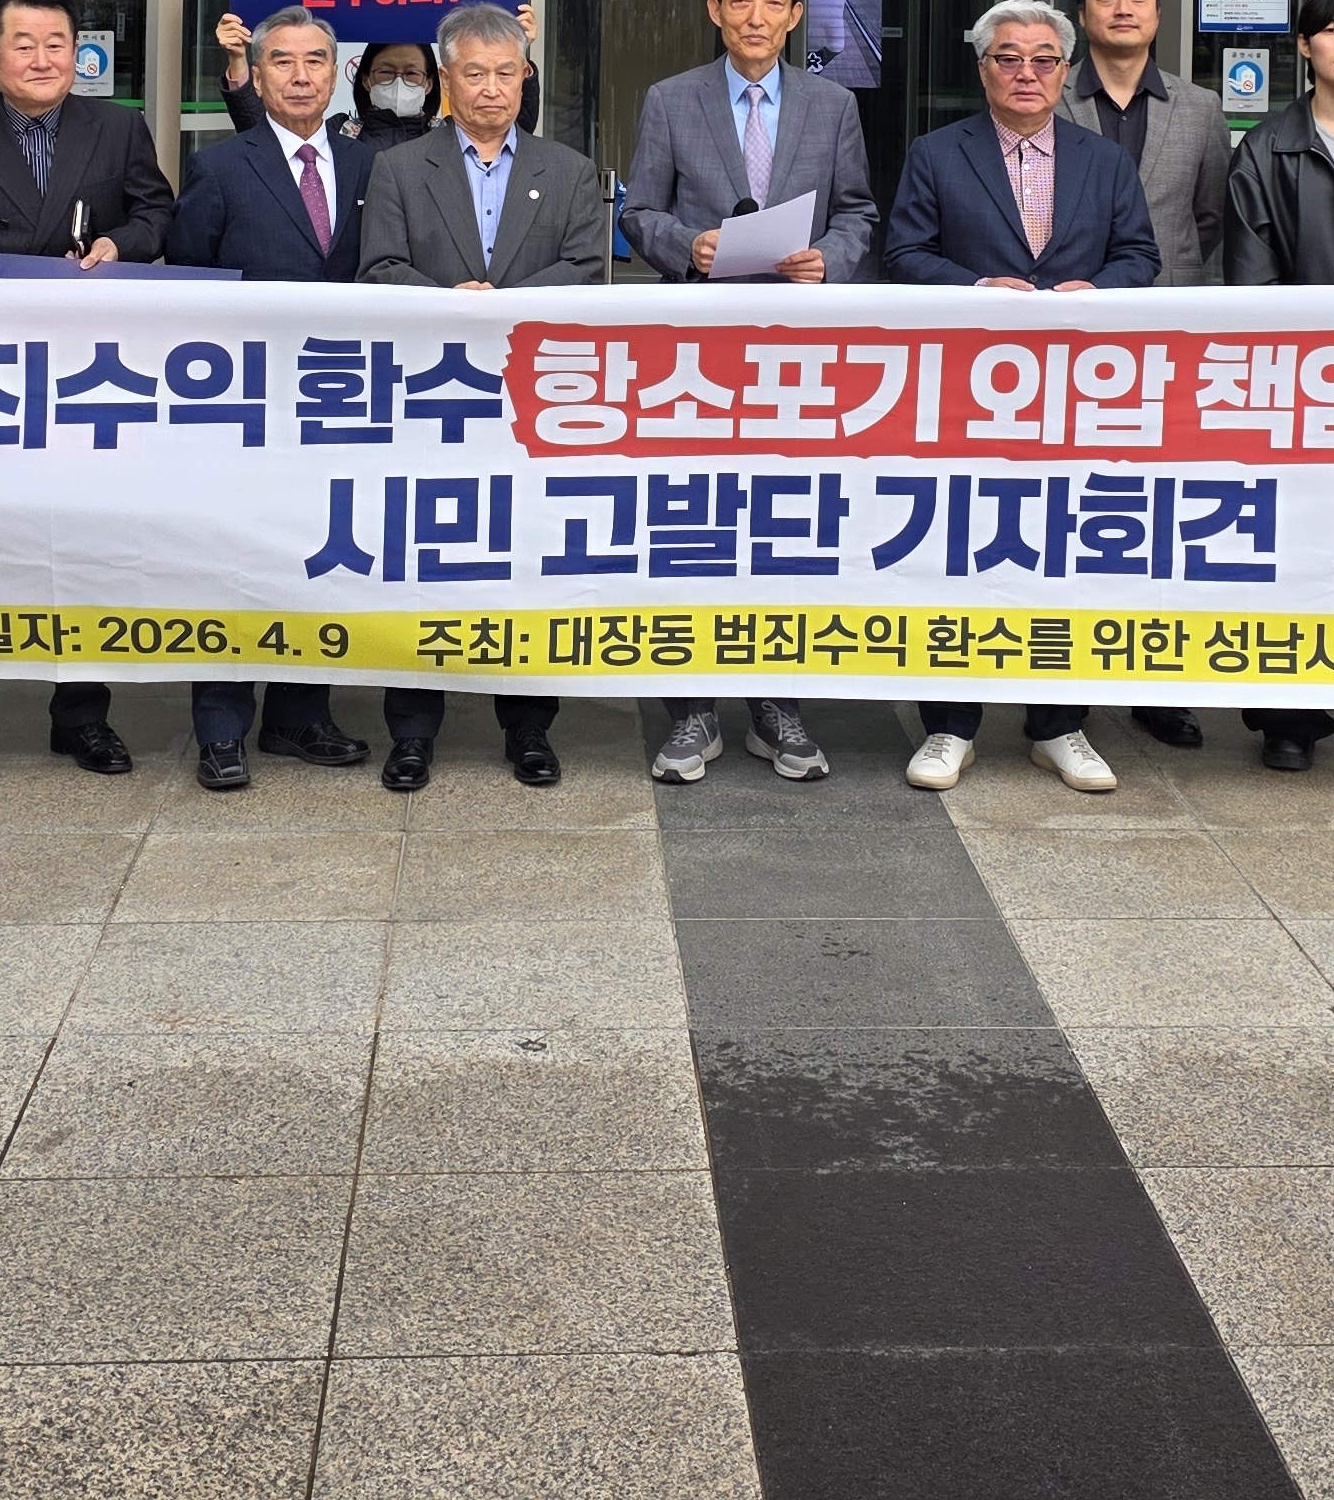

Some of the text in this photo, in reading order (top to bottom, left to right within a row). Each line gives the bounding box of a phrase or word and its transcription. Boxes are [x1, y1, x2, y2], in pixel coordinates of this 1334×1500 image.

[295, 336, 504, 445] 환수
[533, 339, 945, 446] 항소포기
[964, 342, 1177, 448] 외압
[304, 471, 1278, 583] 시민 고발단 기자회견
[99, 616, 241, 655] 2026.
[256, 620, 303, 656] 4.
[318, 621, 350, 658] 9
[415, 615, 532, 667] 주최:
[548, 614, 696, 666] 대장동
[713, 613, 907, 667] 범죄수익
[926, 615, 1074, 671] 환수를
[1090, 617, 1190, 673] 위한
